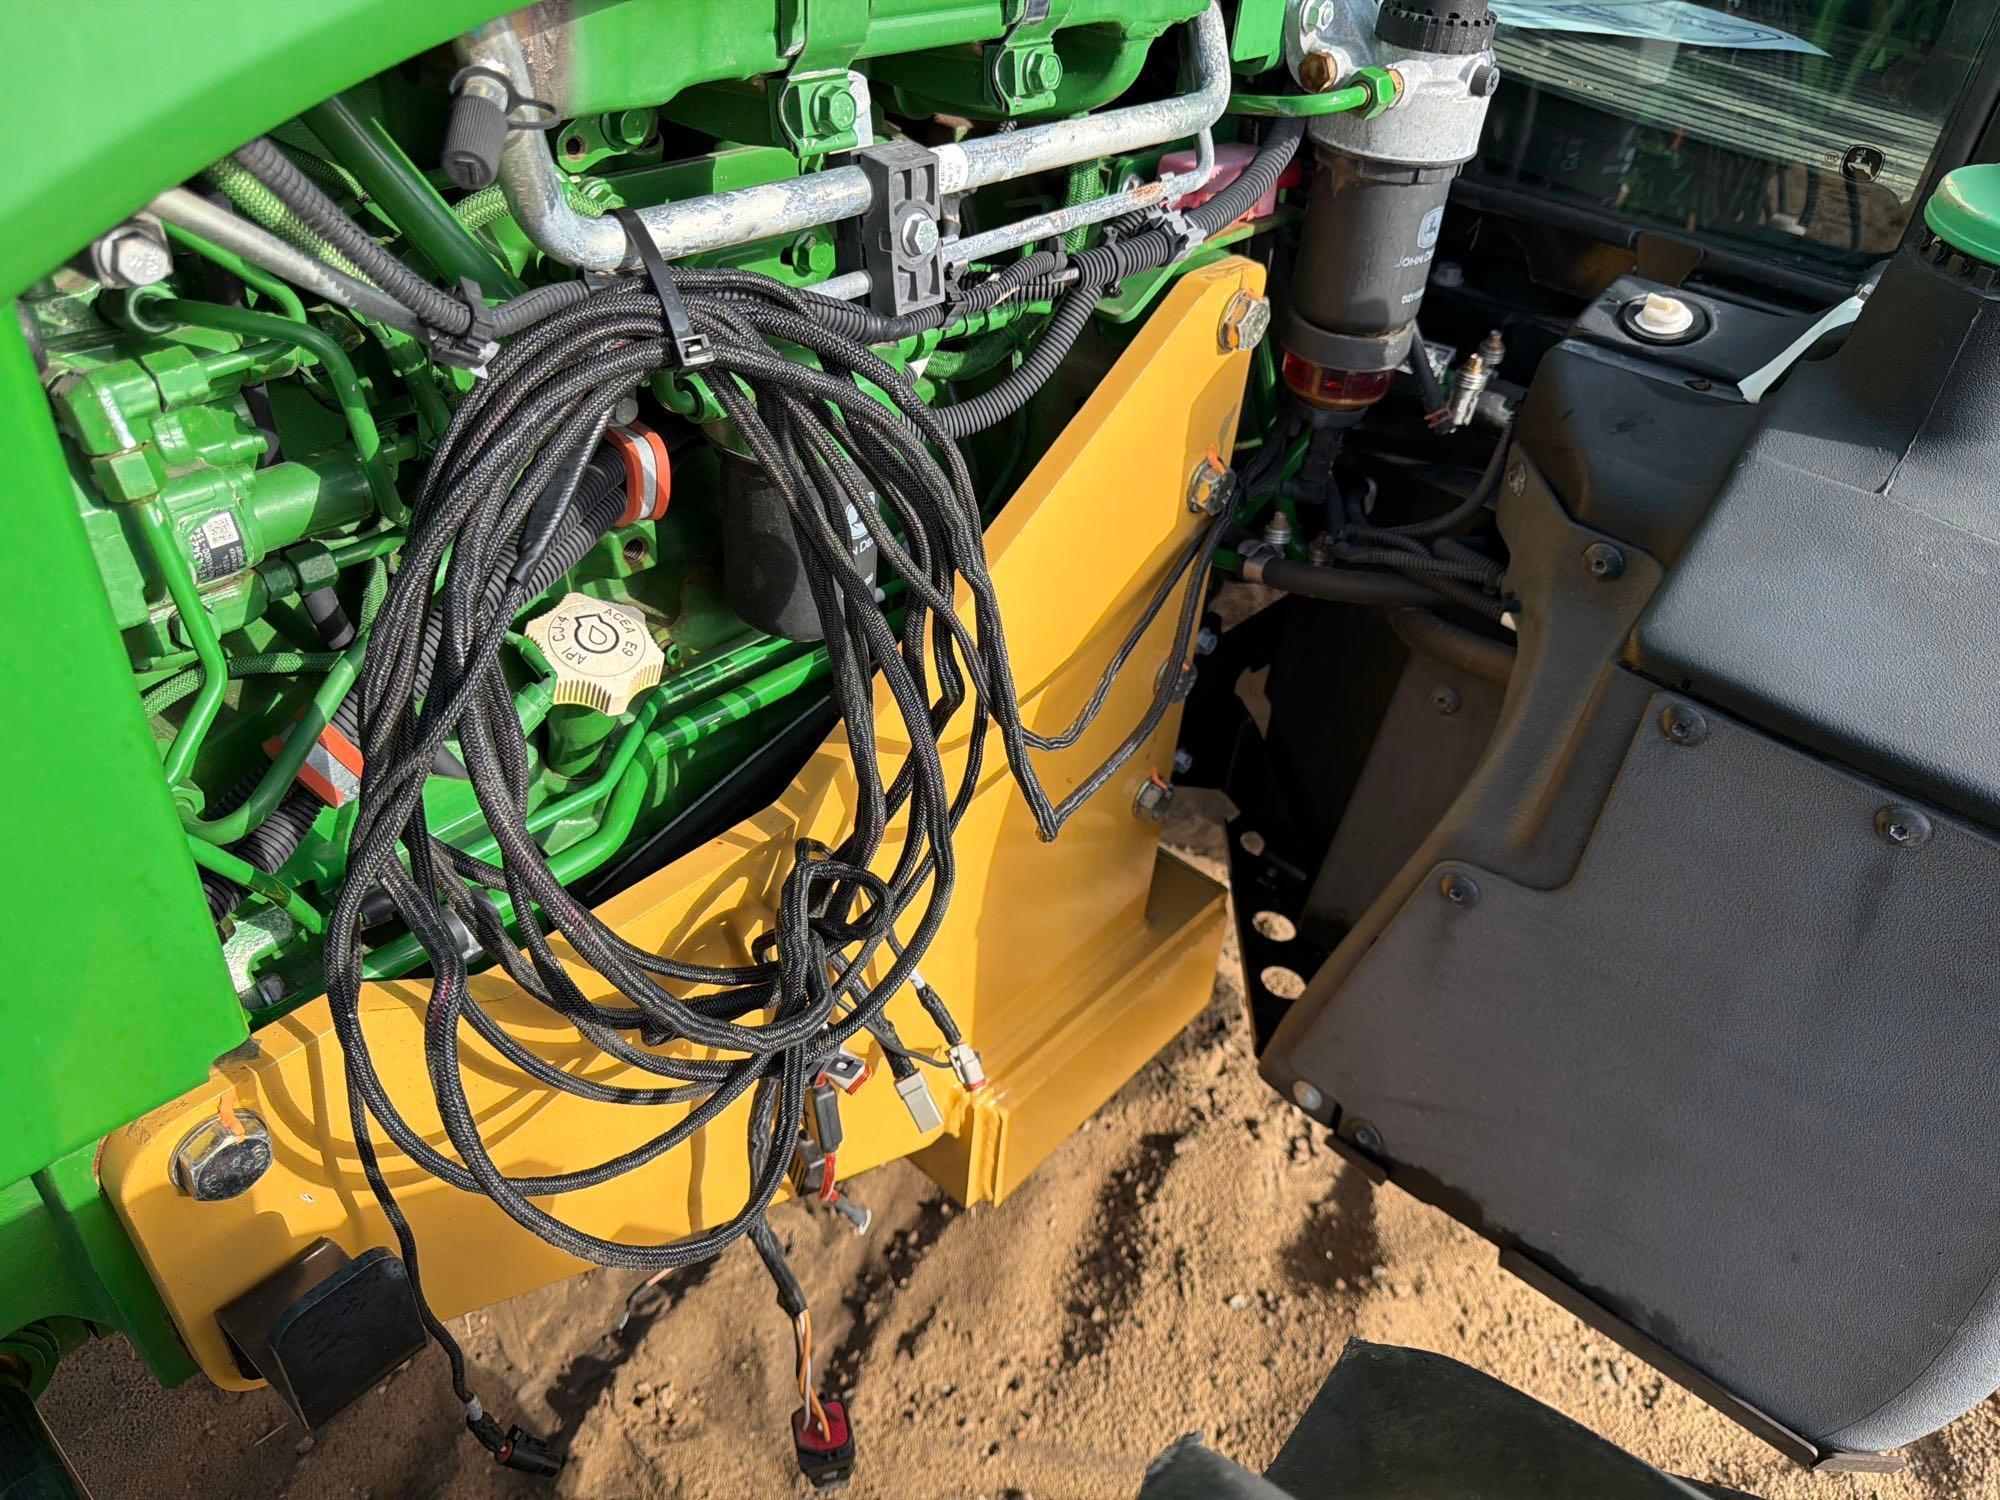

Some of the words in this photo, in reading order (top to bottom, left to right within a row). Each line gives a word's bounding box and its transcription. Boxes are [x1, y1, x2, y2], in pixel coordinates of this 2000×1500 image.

[1394, 254, 1424, 268] JOHN
[603, 608, 636, 634] ACEA
[621, 640, 638, 657] E9
[561, 647, 588, 665] API
